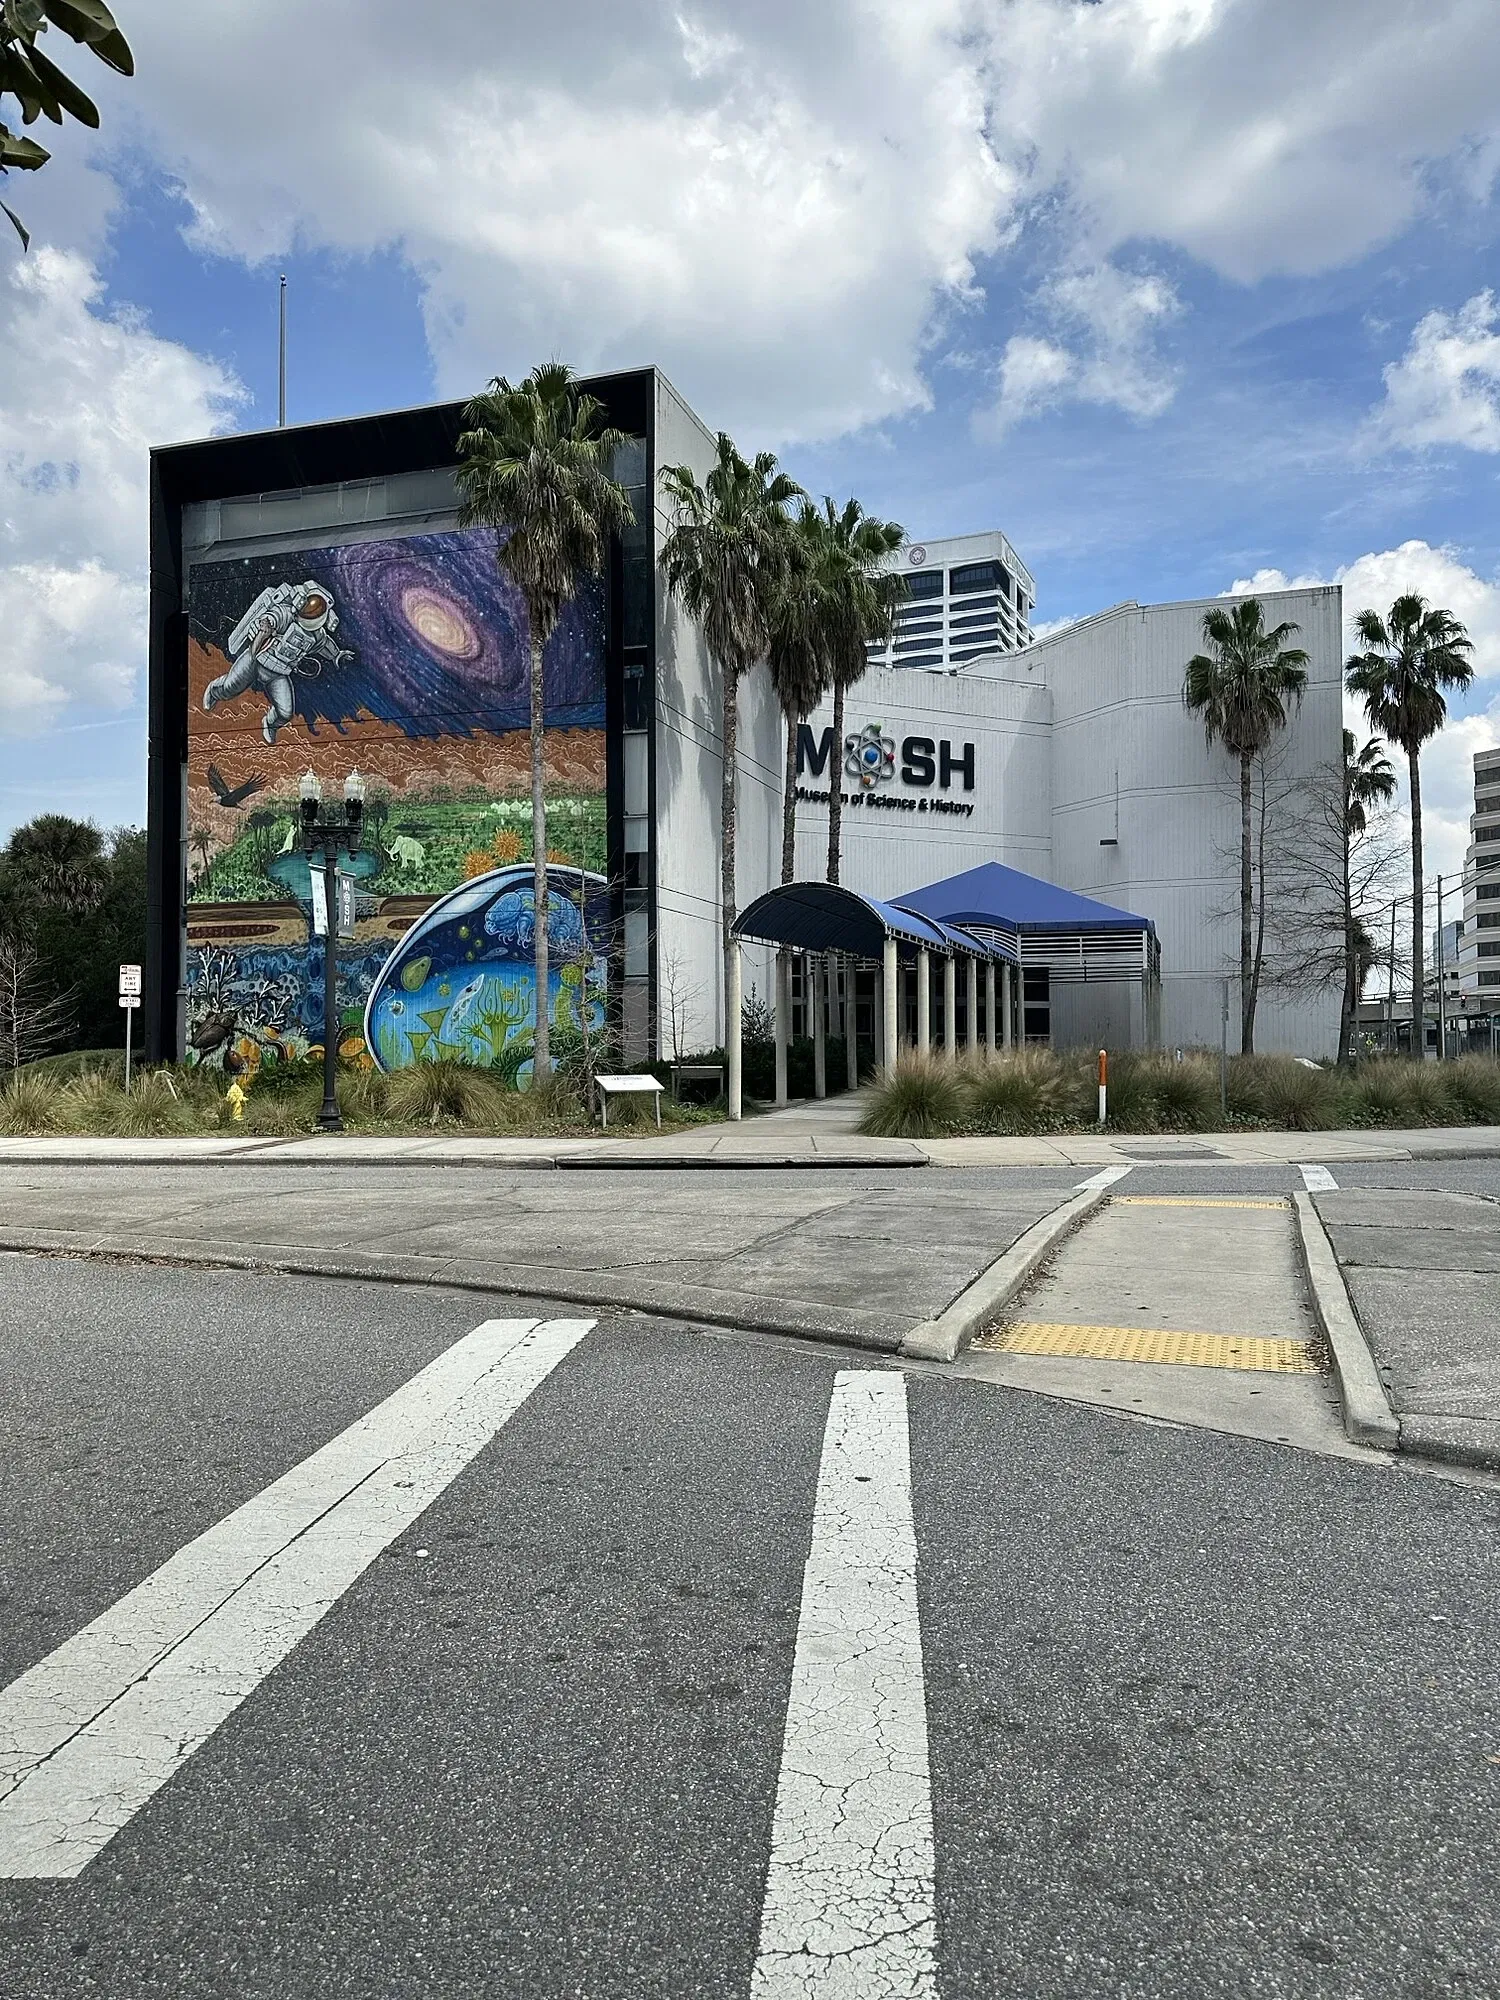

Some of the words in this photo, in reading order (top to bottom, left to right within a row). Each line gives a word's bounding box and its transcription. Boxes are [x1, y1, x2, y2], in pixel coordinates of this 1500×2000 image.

[795, 786, 849, 804] Musem
[851, 792, 865, 805] of
[866, 793, 917, 810] Science
[918, 798, 928, 811] &
[930, 798, 974, 817] History
